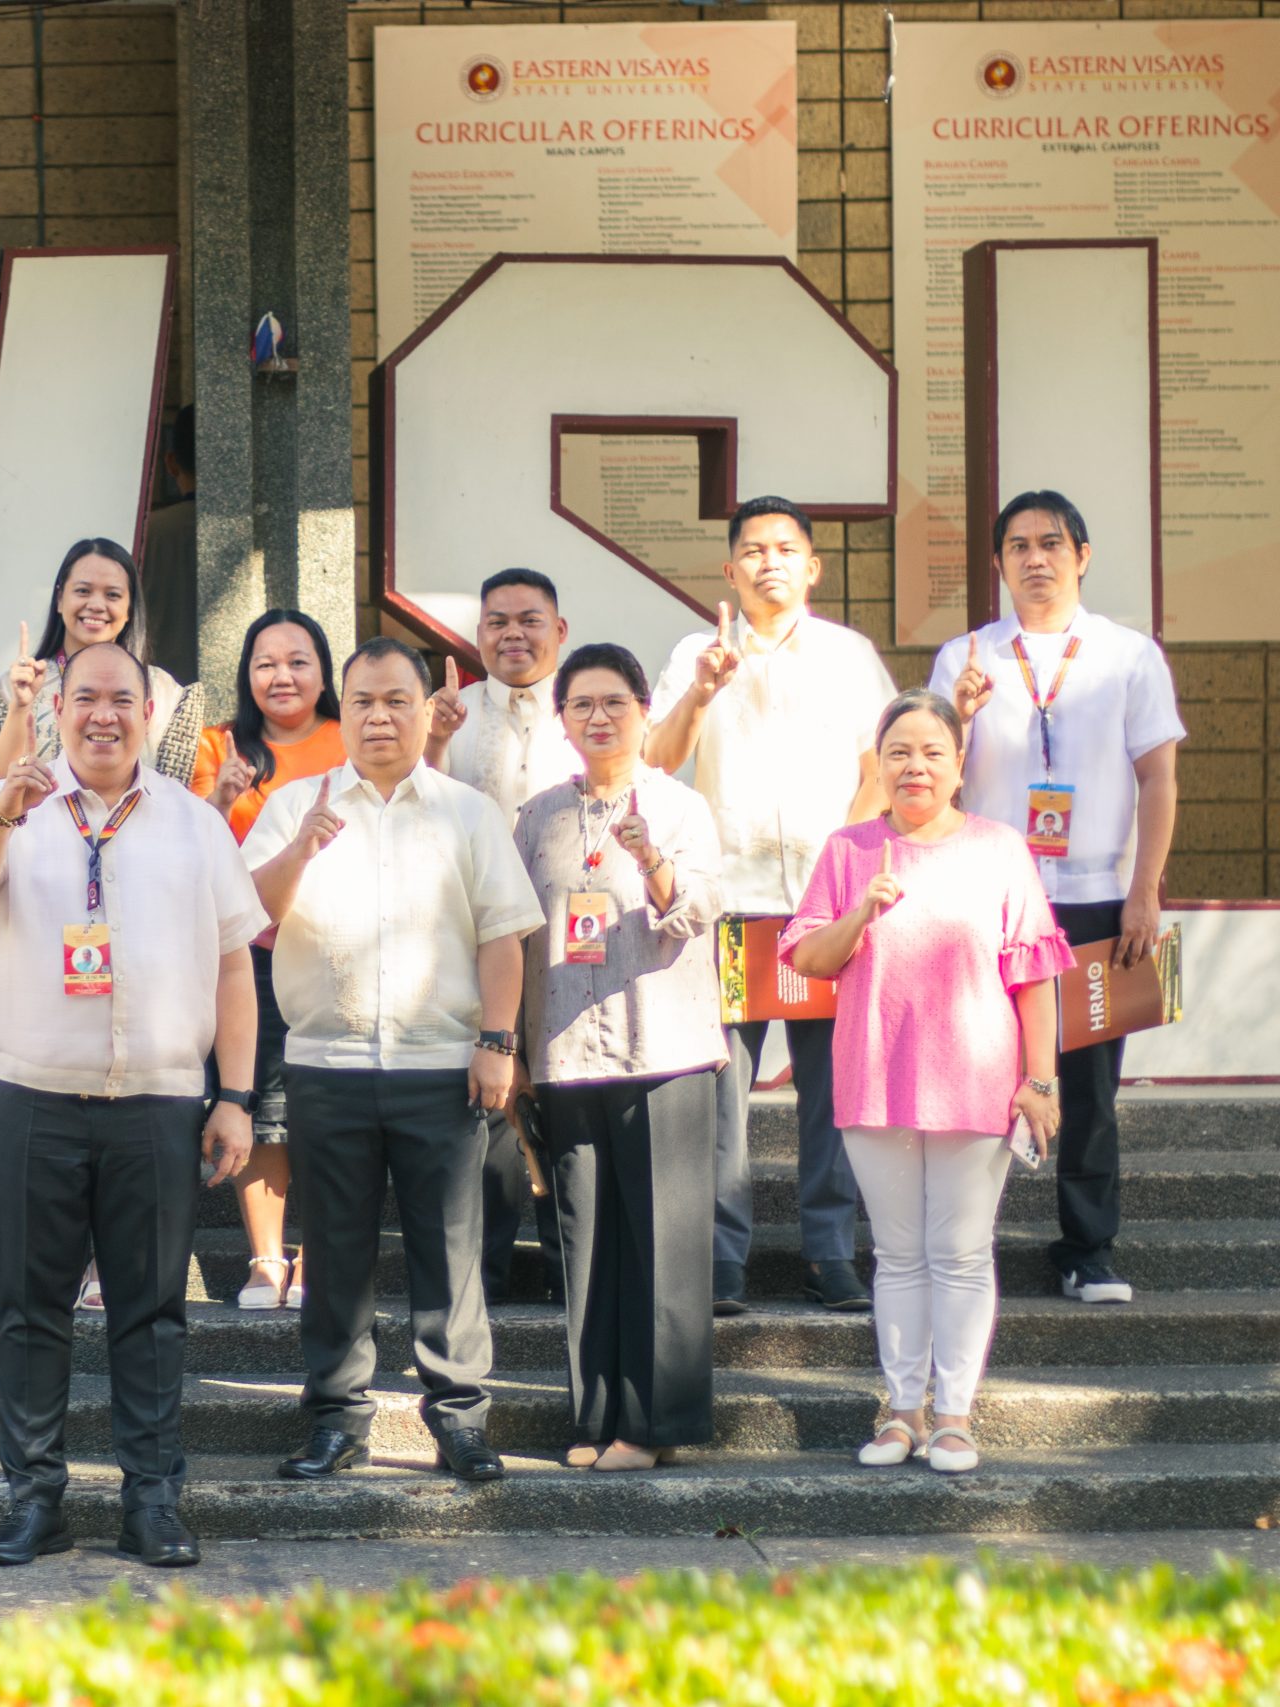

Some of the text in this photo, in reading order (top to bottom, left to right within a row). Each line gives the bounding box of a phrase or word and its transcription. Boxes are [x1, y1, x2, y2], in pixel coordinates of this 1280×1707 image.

[513, 58, 710, 78] EASTERN VISAYAS
[1029, 54, 1224, 74] EASTERN VISAYAS
[513, 83, 710, 96] STATE UNIVERSITY
[1029, 79, 1225, 92] STATE UNIVERSITY
[416, 118, 756, 144] CURRICULAR OFFERINGS
[932, 114, 1270, 140] CURRICULAR OFFERINGS
[546, 146, 626, 156] MAIN CAMPUS
[1042, 142, 1160, 152] EXTERNAL CAMPUSES
[1088, 961, 1105, 1032] HRMO
